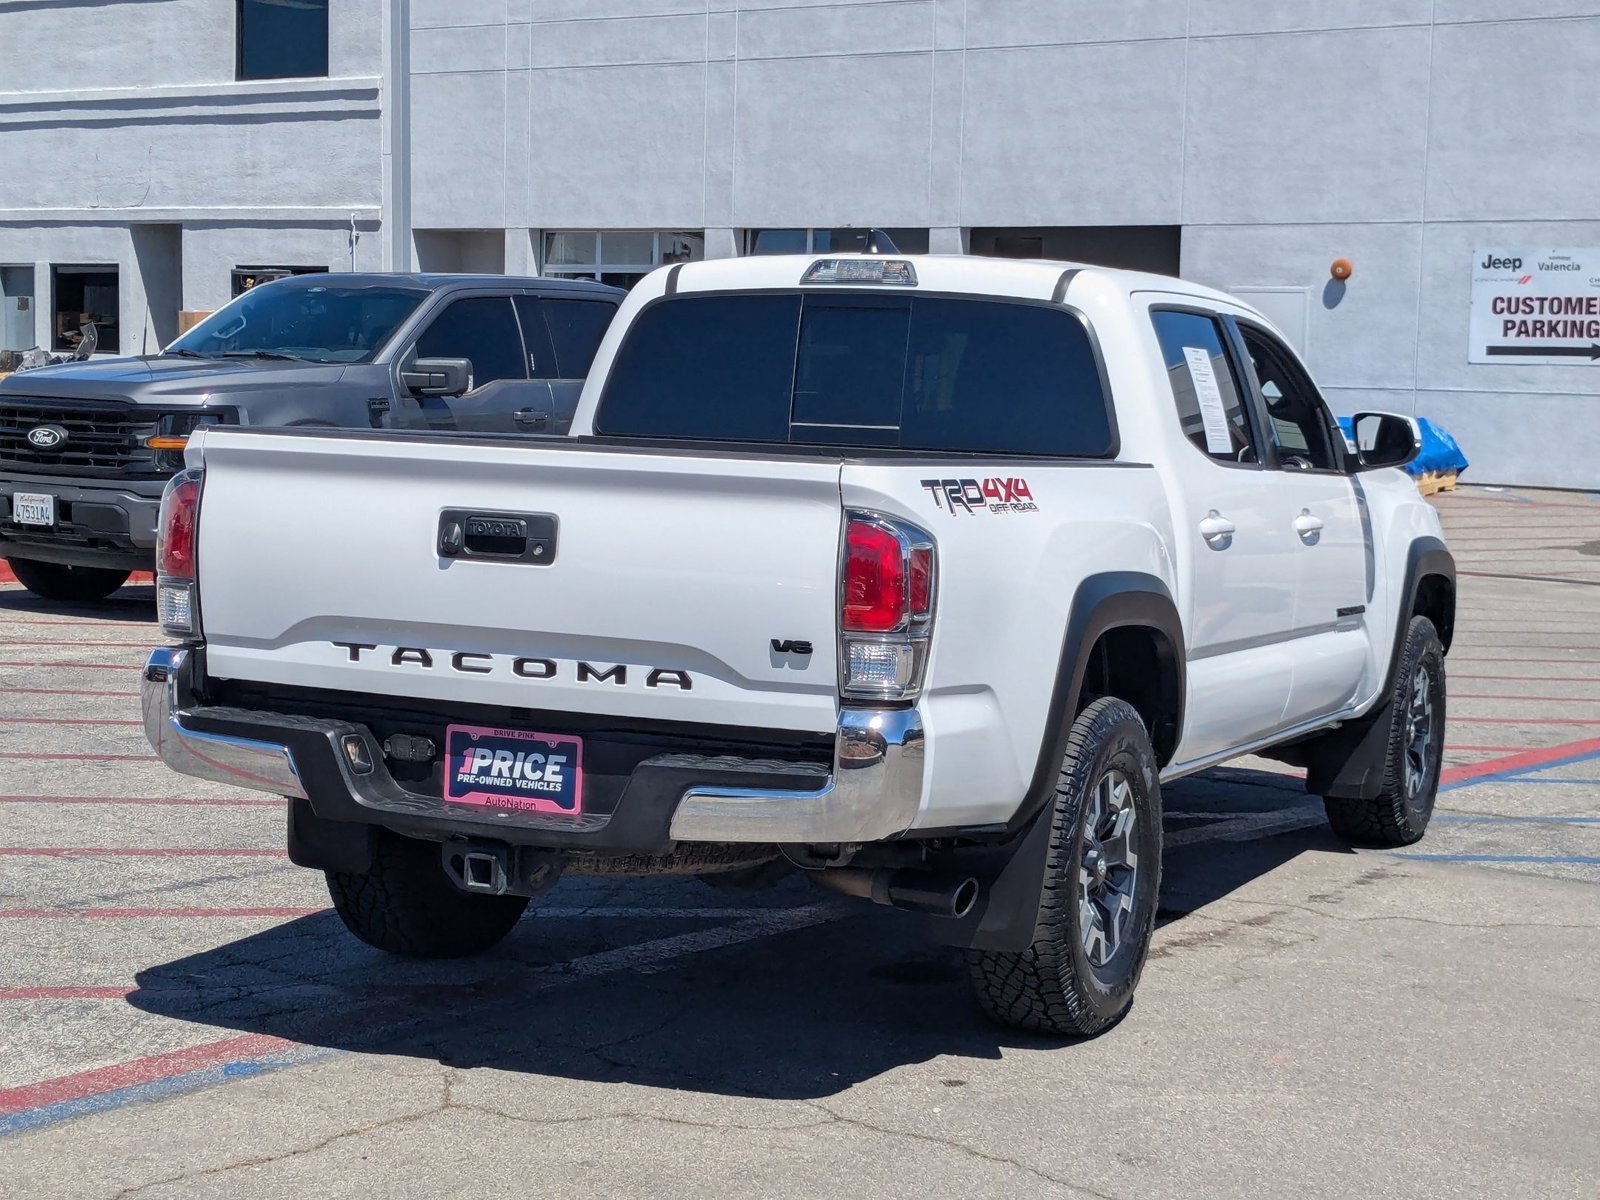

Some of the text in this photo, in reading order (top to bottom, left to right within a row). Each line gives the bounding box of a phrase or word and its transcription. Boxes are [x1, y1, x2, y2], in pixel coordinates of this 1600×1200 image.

[1481, 254, 1523, 272] Jeep
[1537, 262, 1581, 271] Valencia
[1491, 296, 1600, 316] CUSTOME
[1502, 319, 1600, 339] PARKING
[33, 430, 54, 444] Ford
[920, 479, 987, 516] TRD
[988, 502, 1039, 514] OFF ROAD
[469, 521, 521, 537] TOYOTA
[770, 638, 814, 655] V6
[331, 641, 694, 691] TACOMA
[493, 729, 536, 740] DRIVE PINK
[457, 773, 562, 792] PRE-OWNED VEHICLES
[485, 796, 537, 810] AutoNation
